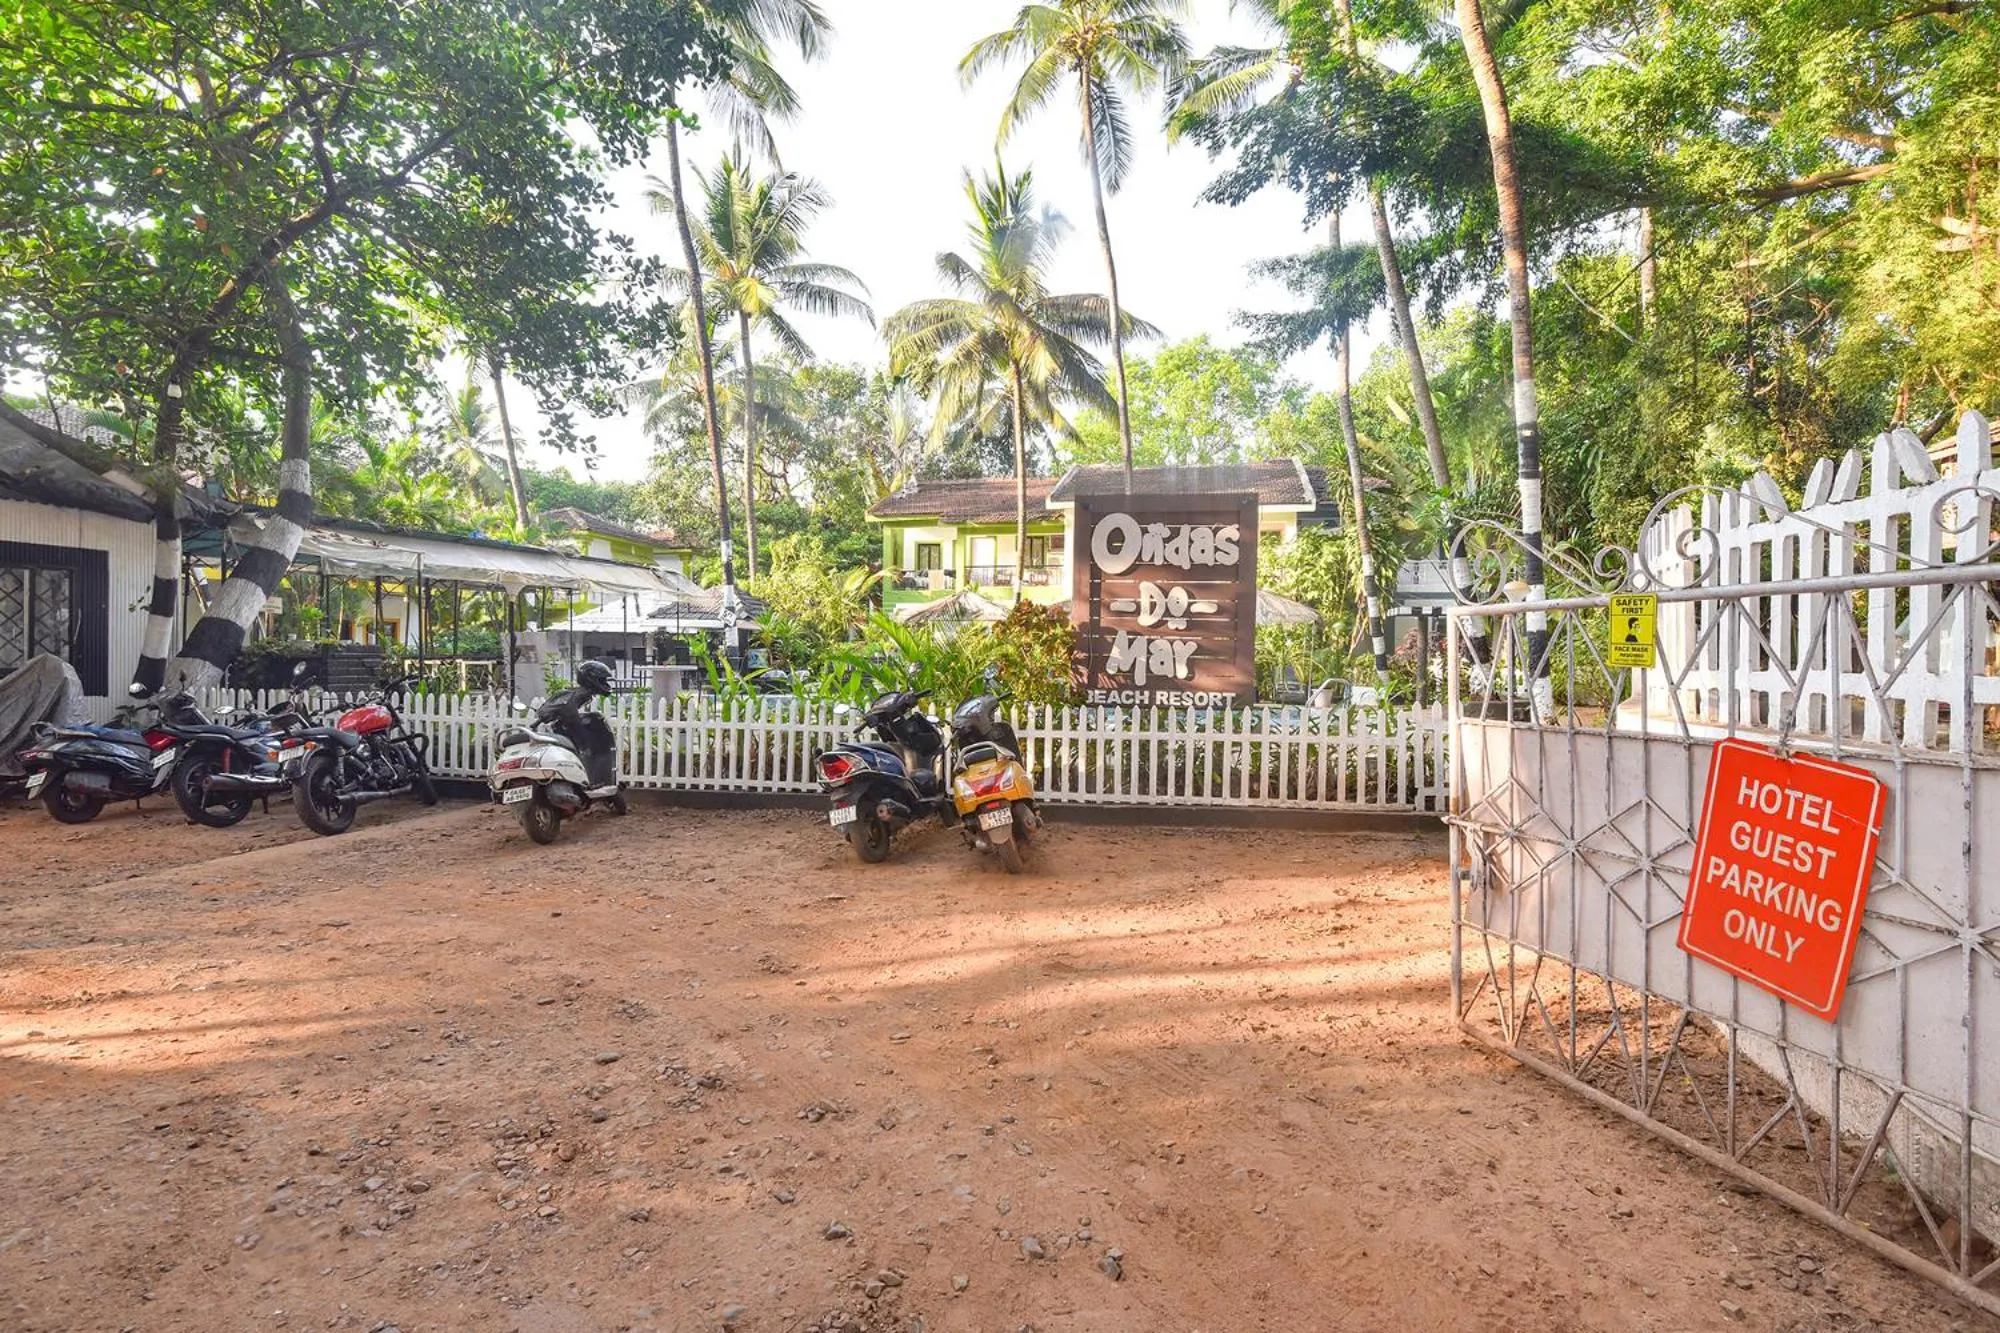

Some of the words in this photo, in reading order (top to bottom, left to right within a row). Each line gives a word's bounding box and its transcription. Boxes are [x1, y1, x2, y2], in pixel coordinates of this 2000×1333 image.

[1155, 690, 1236, 707] RESORT
[1737, 776, 1840, 835] HOTEL
[1730, 821, 1837, 879] GUEST
[1706, 856, 1842, 932] PARKING
[1723, 909, 1805, 963] ONLY
